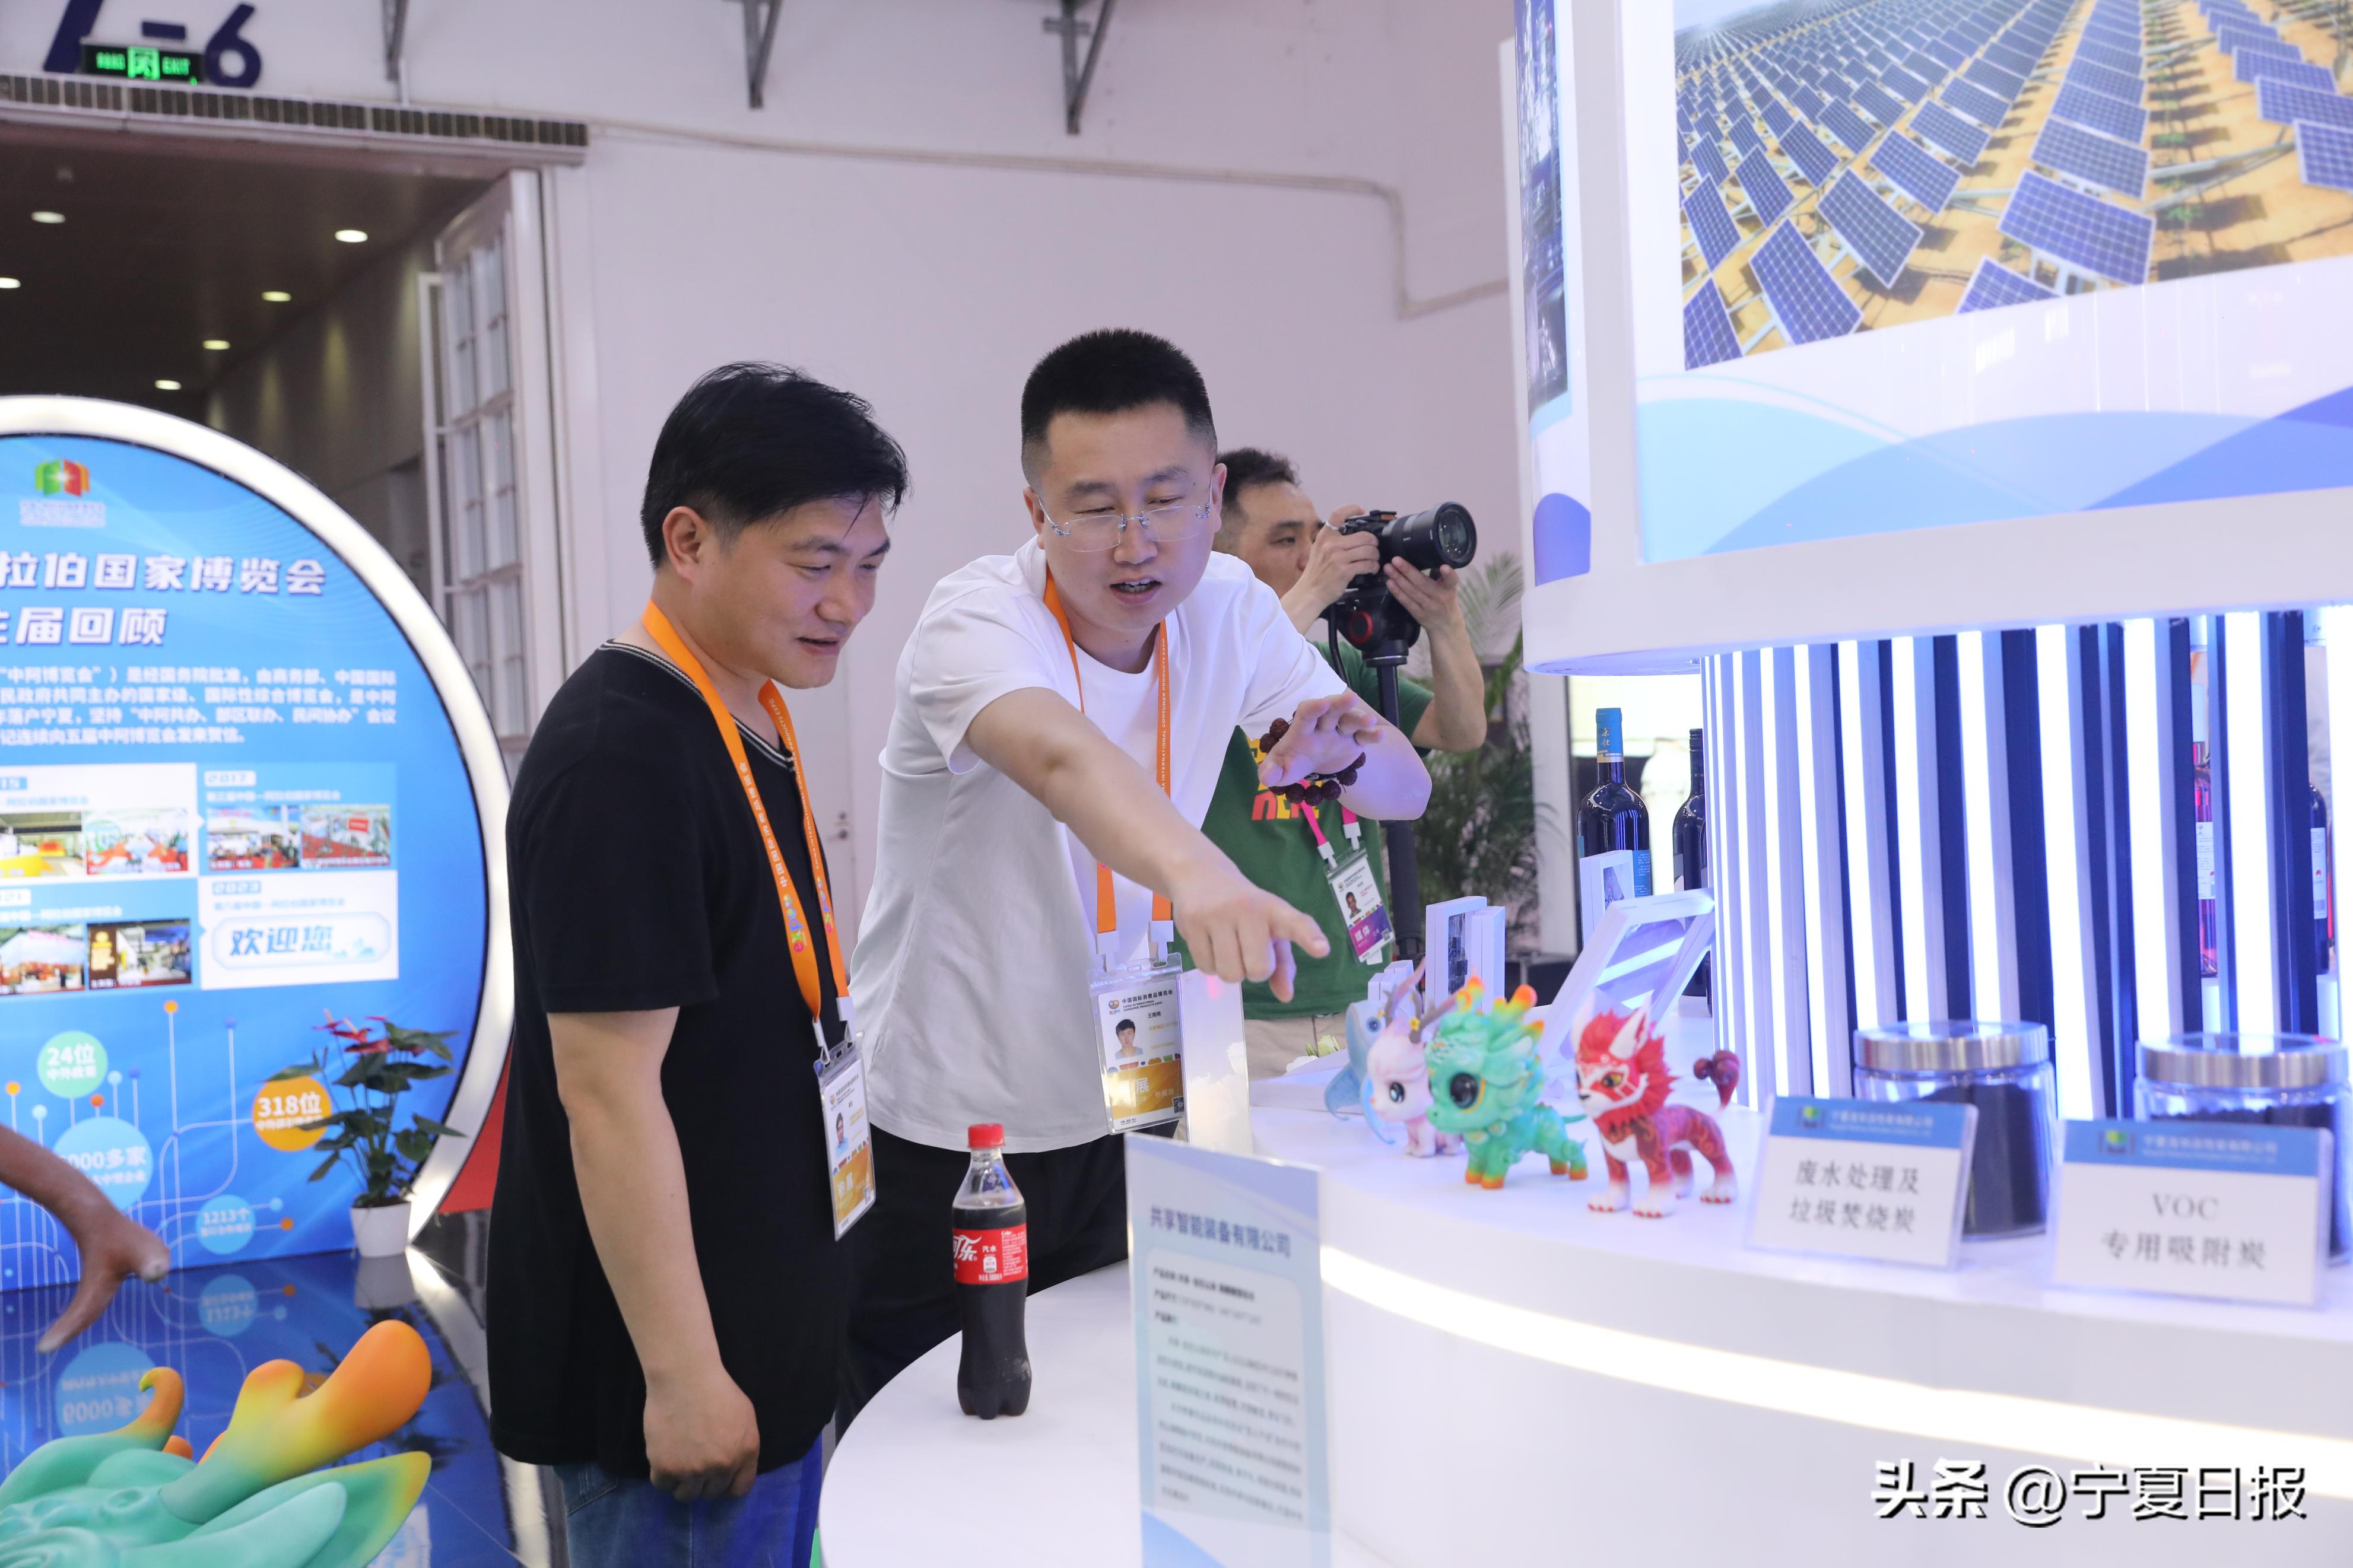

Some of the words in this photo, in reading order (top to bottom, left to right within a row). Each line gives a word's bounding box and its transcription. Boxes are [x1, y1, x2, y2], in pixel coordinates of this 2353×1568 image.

[0, 551, 326, 595] 拉伯国家博览会
[769, 698, 781, 715] EXPO
[230, 925, 332, 956] 欢迎您
[47, 1043, 96, 1066] 24位
[258, 1091, 322, 1117] 318位
[61, 1146, 147, 1170] 000多家
[1795, 1159, 1920, 1195] 废水处理及
[2152, 1192, 2219, 1220] VOC
[1151, 1206, 1291, 1258] 共享智能装备有限公司
[2103, 1229, 2266, 1270] 专用吸附炭
